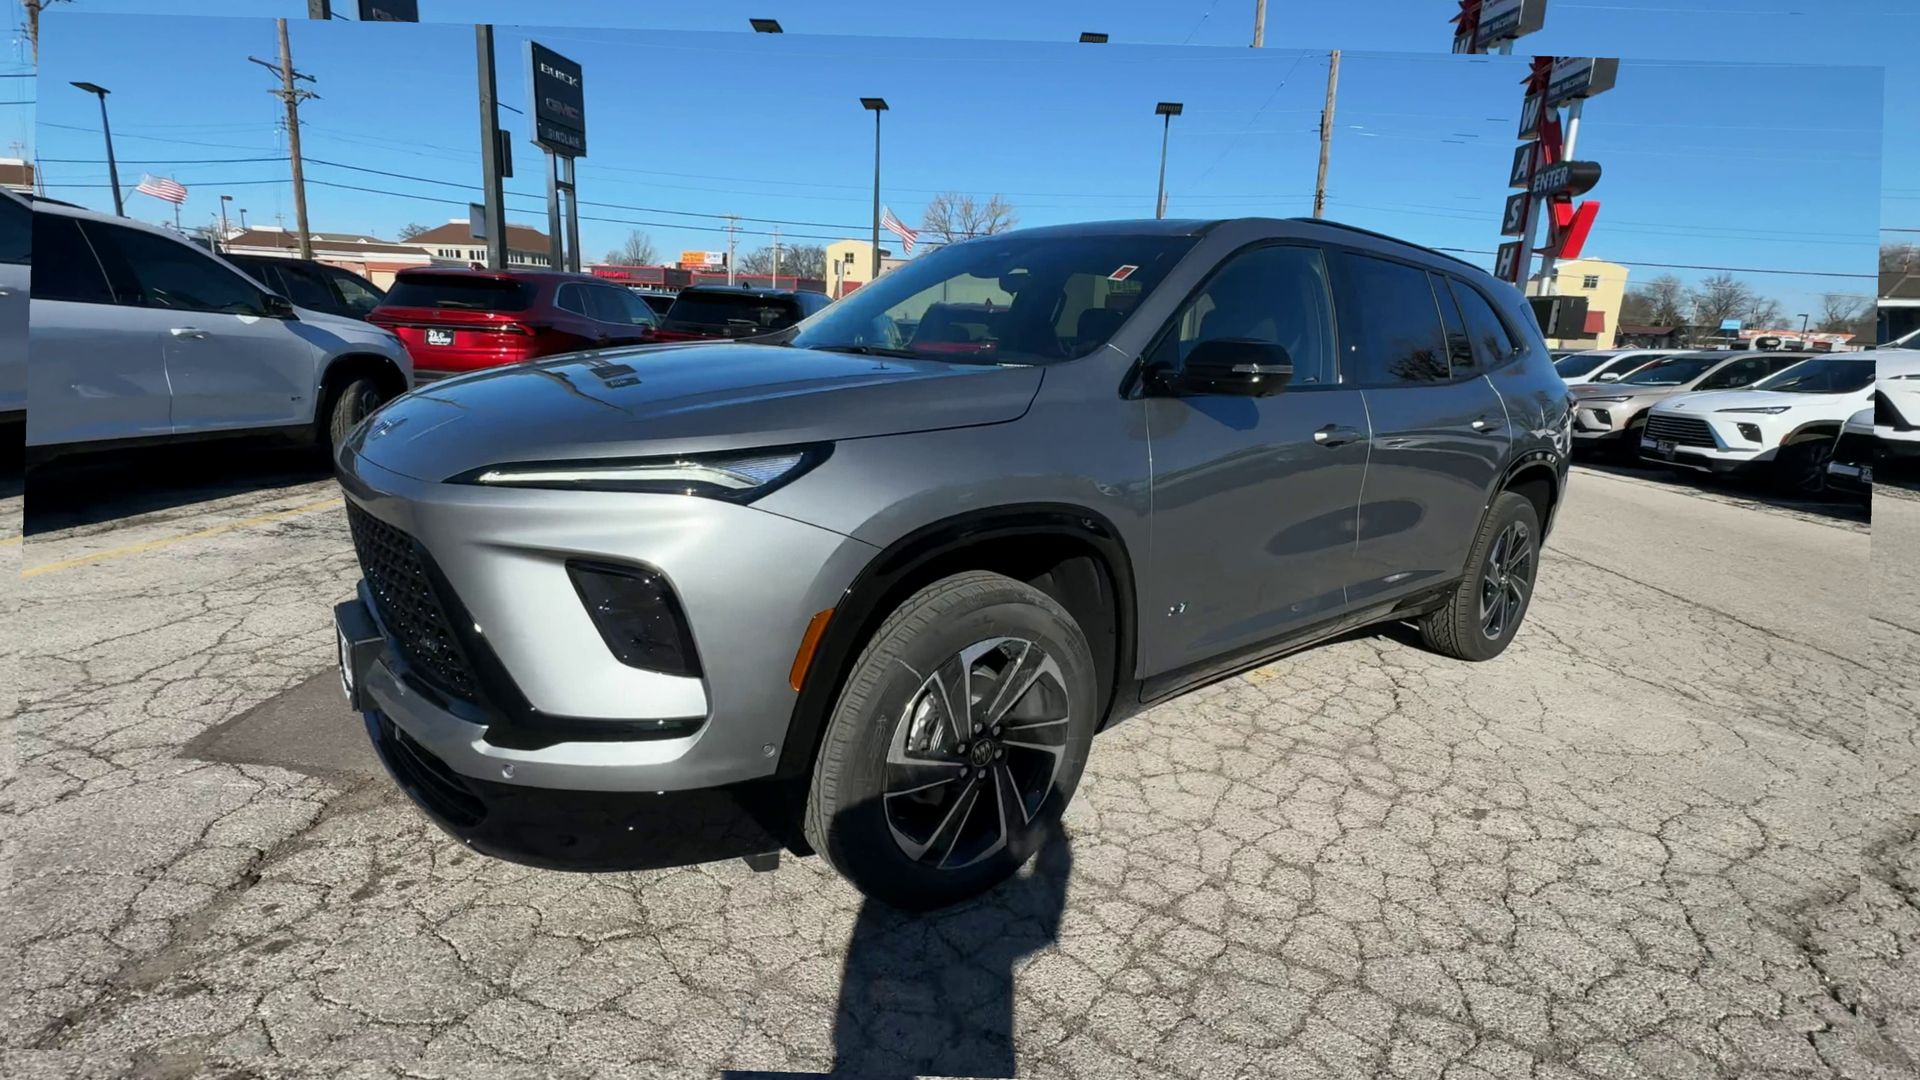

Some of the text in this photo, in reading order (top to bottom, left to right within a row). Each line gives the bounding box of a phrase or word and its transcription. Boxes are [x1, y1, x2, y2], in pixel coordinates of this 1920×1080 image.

[540, 62, 578, 88] BUICK
[546, 97, 578, 119] GMC
[1497, 95, 1542, 277] WASH
[1533, 166, 1568, 192] ENTER
